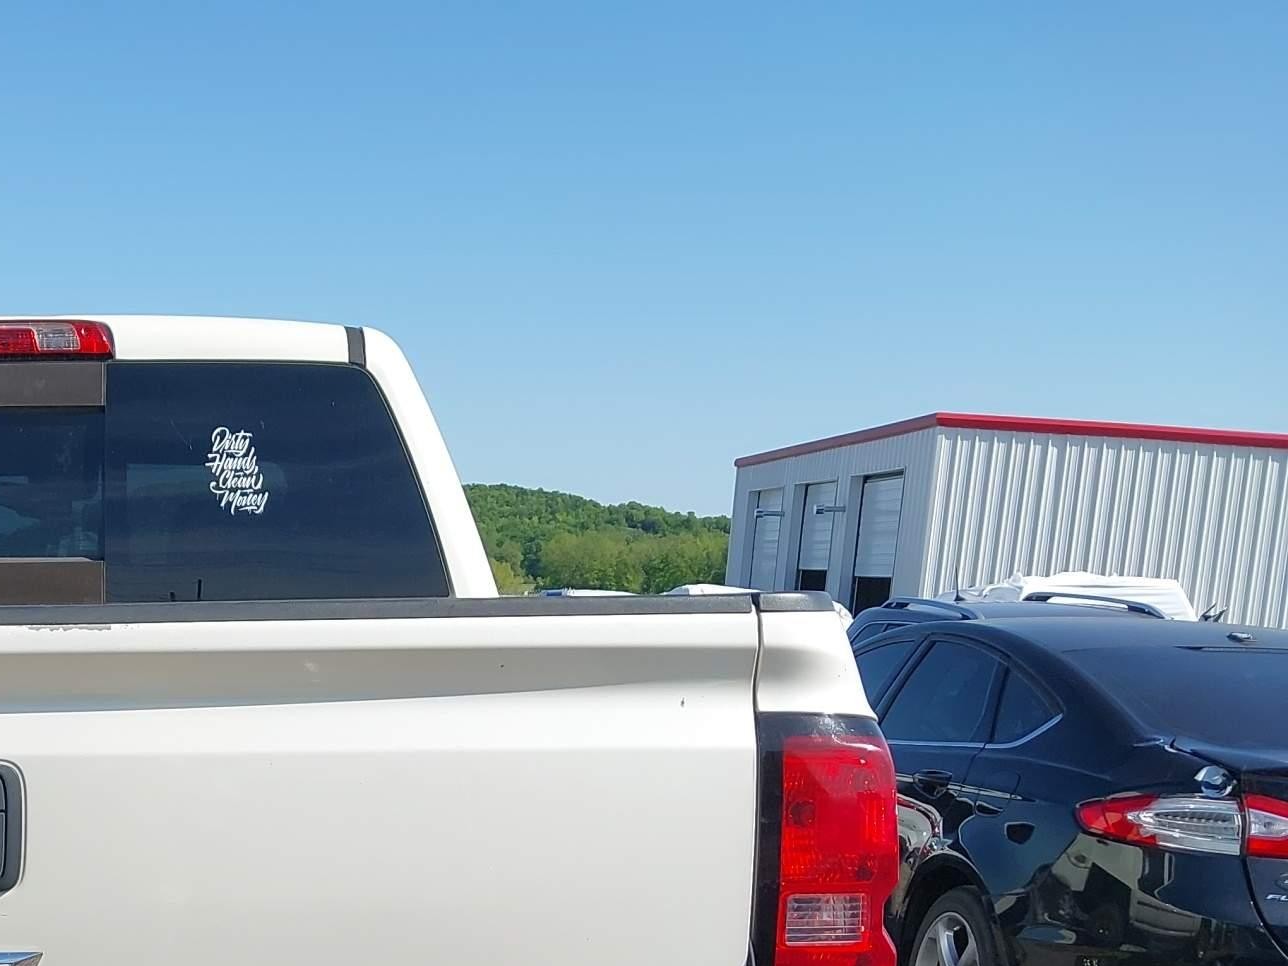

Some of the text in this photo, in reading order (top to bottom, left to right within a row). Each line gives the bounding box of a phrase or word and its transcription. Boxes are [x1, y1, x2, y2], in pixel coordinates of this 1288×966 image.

[212, 426, 252, 456] Dirty
[219, 469, 263, 490] Clean
[209, 481, 269, 515] Money
